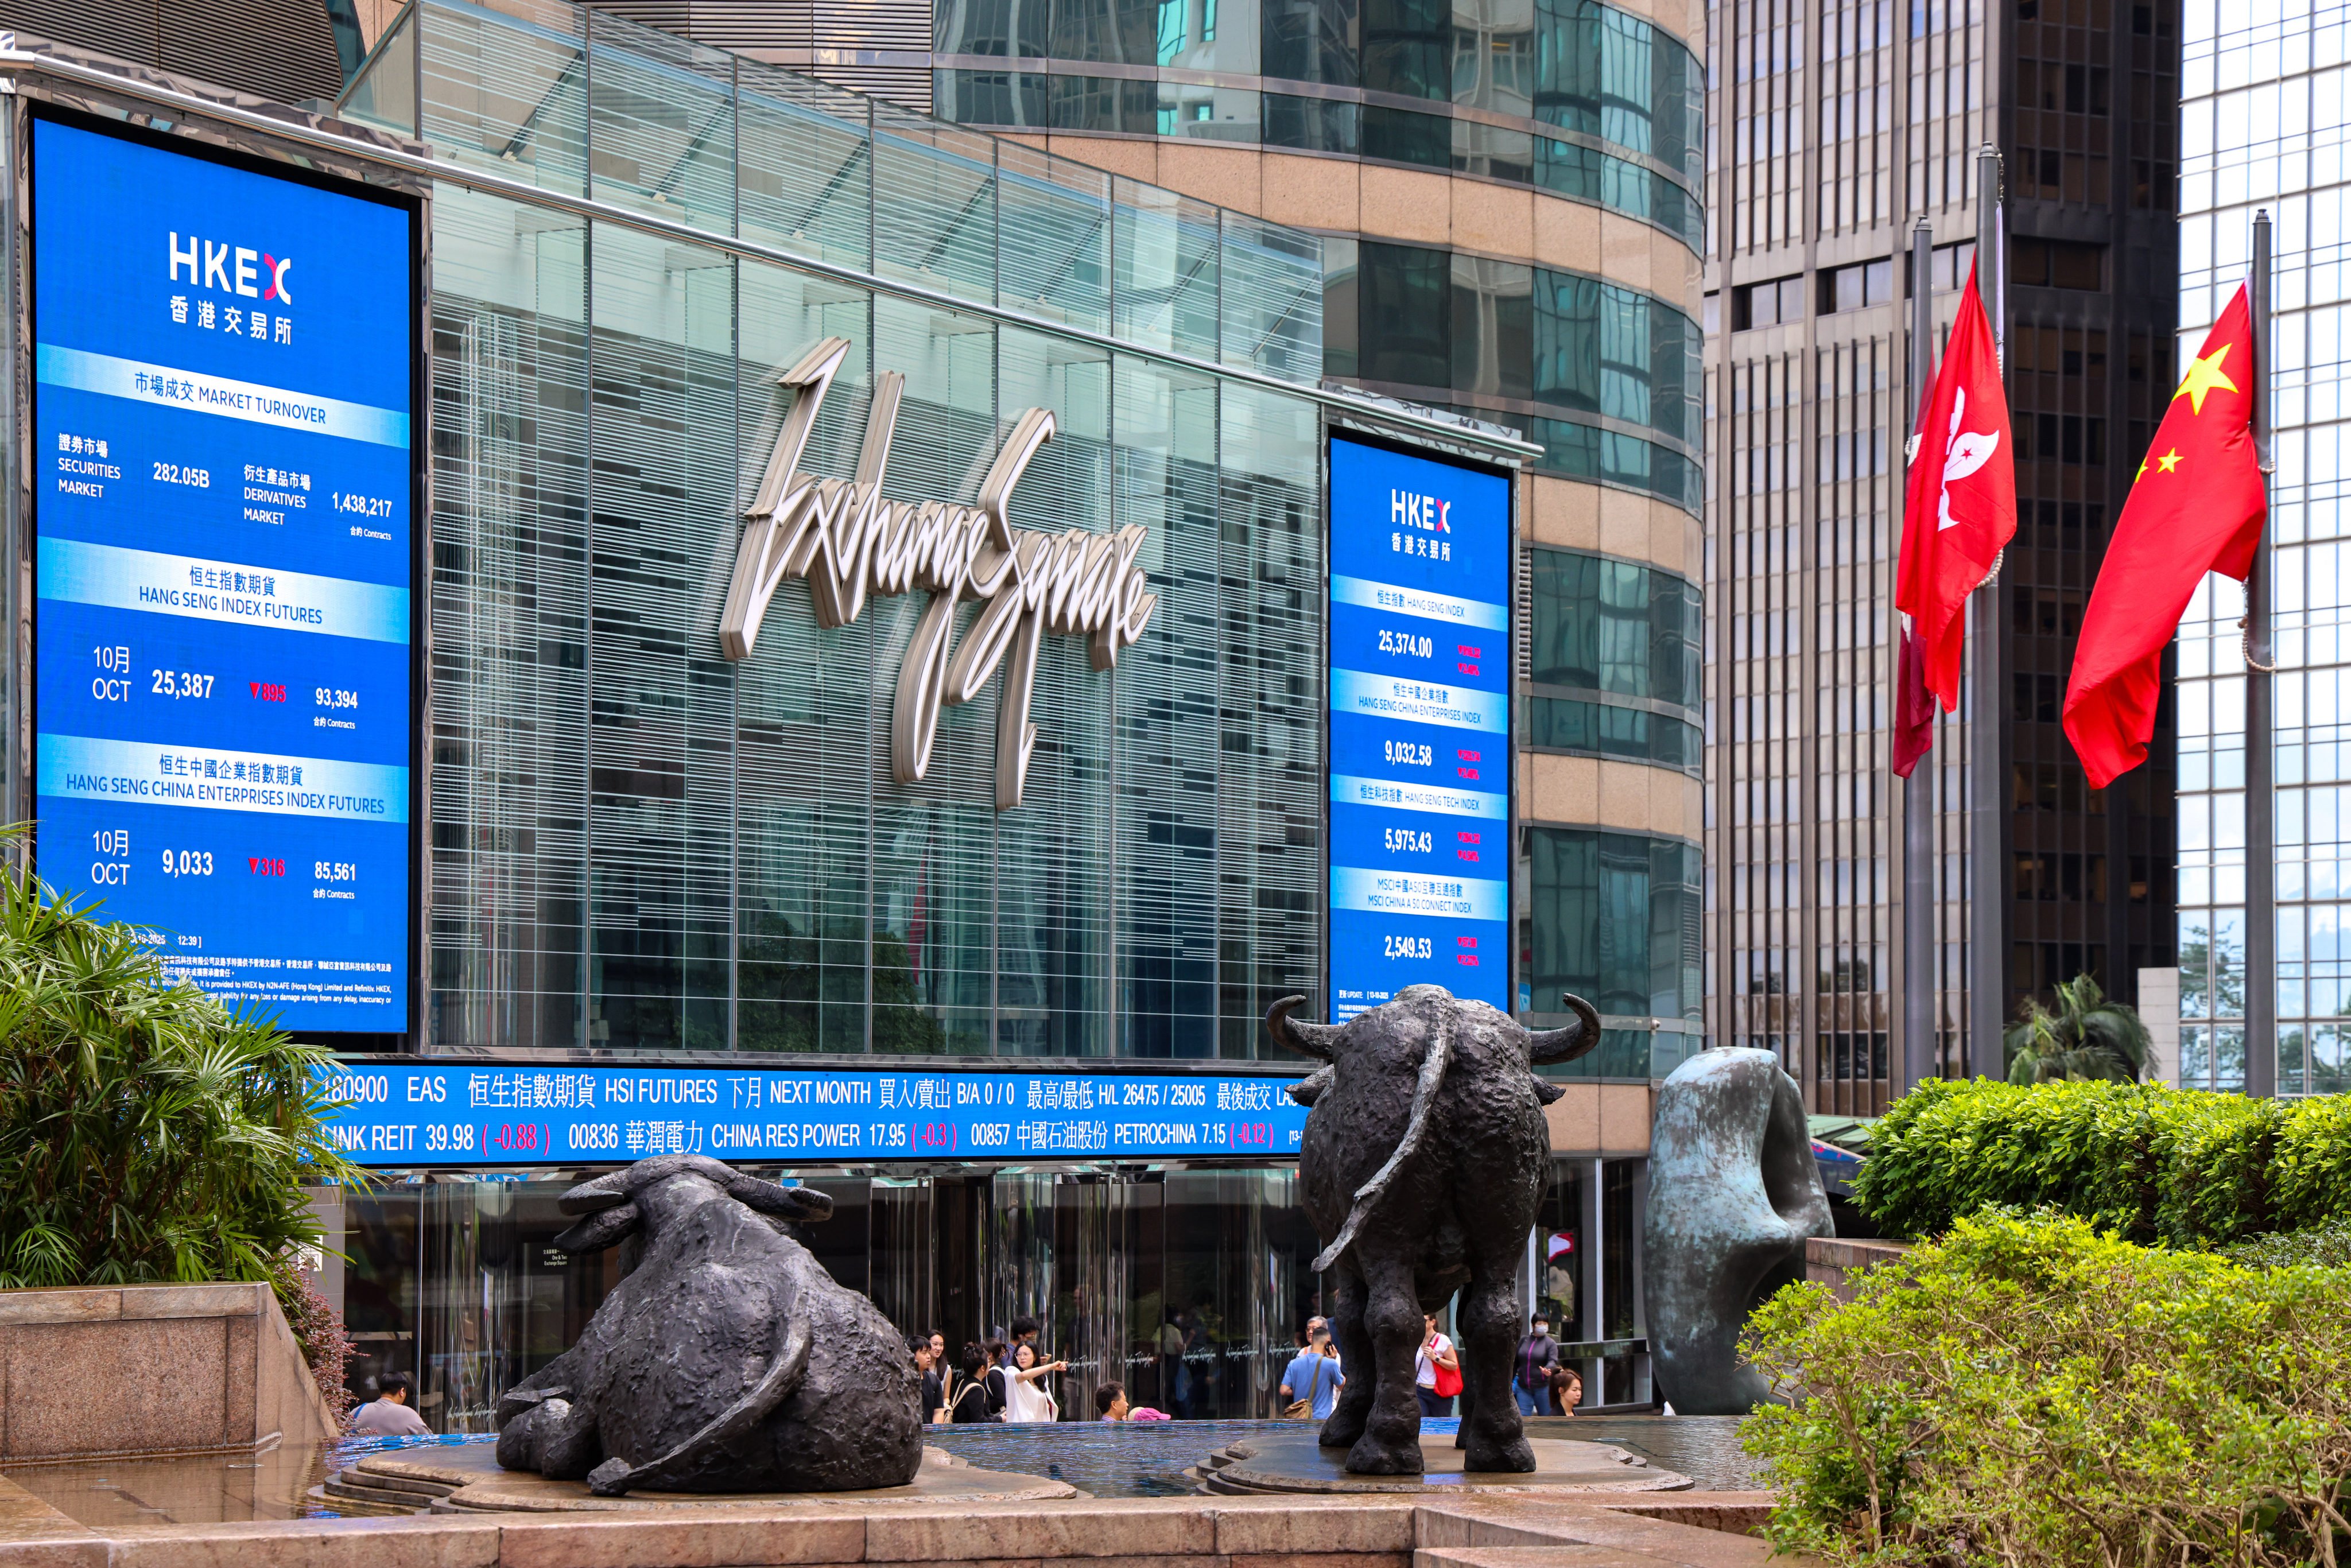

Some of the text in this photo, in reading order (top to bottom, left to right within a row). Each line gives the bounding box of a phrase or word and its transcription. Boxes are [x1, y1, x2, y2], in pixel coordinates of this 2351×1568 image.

[170, 232, 291, 305] HKEX
[170, 296, 291, 345] 香港交易所
[135, 372, 325, 424] 市場成交 MARKET TURNOVER
[59, 458, 121, 479] SECURITIES
[154, 462, 210, 487] 282.05B
[244, 464, 311, 491] 衍生產品市場
[59, 479, 103, 497] MARKET
[245, 487, 306, 508] DERIVATIVES
[245, 507, 285, 525] MARKET
[333, 492, 391, 517] 1,438,217
[1392, 489, 1450, 534] HKEX
[350, 526, 391, 540] 合約 Contracts
[719, 337, 1002, 784] Exchange
[1392, 533, 1450, 562] 香港交易所
[189, 566, 275, 597] 恒生指數期貨
[140, 586, 321, 624] HANG SENG INDEX FUTURES
[1378, 589, 1464, 617] 恒生指數 HANG SENG INDEX
[1379, 630, 1432, 658] 25,374.00
[94, 646, 129, 673] 10月
[93, 678, 131, 701] OCT
[152, 669, 214, 698] 25,387
[1394, 682, 1449, 704] 恒生中國企業指數
[316, 688, 358, 709] 93,394
[1359, 696, 1481, 724] HANG SENG CHINA ENTERPRISES INDEX
[314, 716, 355, 729] 合約 Contracts
[1386, 740, 1431, 766] 9,032.58
[160, 754, 302, 786] 恒生中國企業指數期貨
[67, 772, 385, 814] HANG SENG CHINA ENTERPRISES INDEX FUTURES
[1361, 784, 1479, 810] 恒生科技指數 HANG SENG TECH INDEX
[94, 830, 128, 856] 10月
[1386, 829, 1431, 853] 5,975.43
[92, 863, 130, 885] OCT
[163, 849, 213, 878] 9,033
[261, 858, 285, 876] 316
[315, 861, 355, 882] 85,561
[313, 888, 355, 899] 合約 Contracts
[1368, 895, 1472, 913] MSCI CHINA A 50 CONNECT INDEX
[178, 936, 197, 945] 12:39
[1385, 936, 1431, 960] 2,549.53
[211, 980, 234, 989] provided
[259, 981, 265, 991] by
[291, 983, 306, 992] (Hong
[308, 984, 323, 992] Kong)
[220, 992, 238, 1001] liability
[250, 994, 259, 1002] any
[280, 994, 300, 1003] damage
[301, 995, 318, 1003] arising
[344, 995, 358, 1004] delay,
[359, 996, 384, 1004] inaccuracy
[325, 1075, 388, 1103] 180900
[408, 1076, 446, 1102] EAS
[468, 1073, 596, 1108] 恒生指數期貨
[606, 1078, 634, 1103] HSI
[640, 1079, 717, 1103] FUTURES
[727, 1077, 761, 1108] 下月
[771, 1081, 812, 1103] NEXT
[816, 1081, 870, 1104] MONTH
[879, 1078, 951, 1109] 買入/賣出
[957, 1082, 980, 1104] B/A
[985, 1082, 992, 1104] 0
[1007, 1082, 1014, 1104] 0
[1027, 1080, 1093, 1109] 最高/最低
[1099, 1085, 1119, 1104] H/L
[1123, 1084, 1159, 1105] 26475
[1171, 1085, 1205, 1105] 25005
[1217, 1083, 1271, 1110] 最後成交
[321, 1125, 367, 1151] LINK
[372, 1125, 417, 1150] REIT
[426, 1124, 474, 1150] 39.98
[569, 1124, 618, 1148] 00836
[626, 1120, 703, 1155] 華潤電力
[712, 1124, 762, 1147] CHINA
[766, 1124, 798, 1147] RES
[803, 1124, 860, 1147] POWER
[870, 1124, 906, 1146] 17.95
[972, 1123, 1010, 1146] 00857
[1017, 1120, 1108, 1150] 中國石油股份
[1115, 1123, 1196, 1144] PETROCHINA
[1202, 1123, 1225, 1143] 7.15
